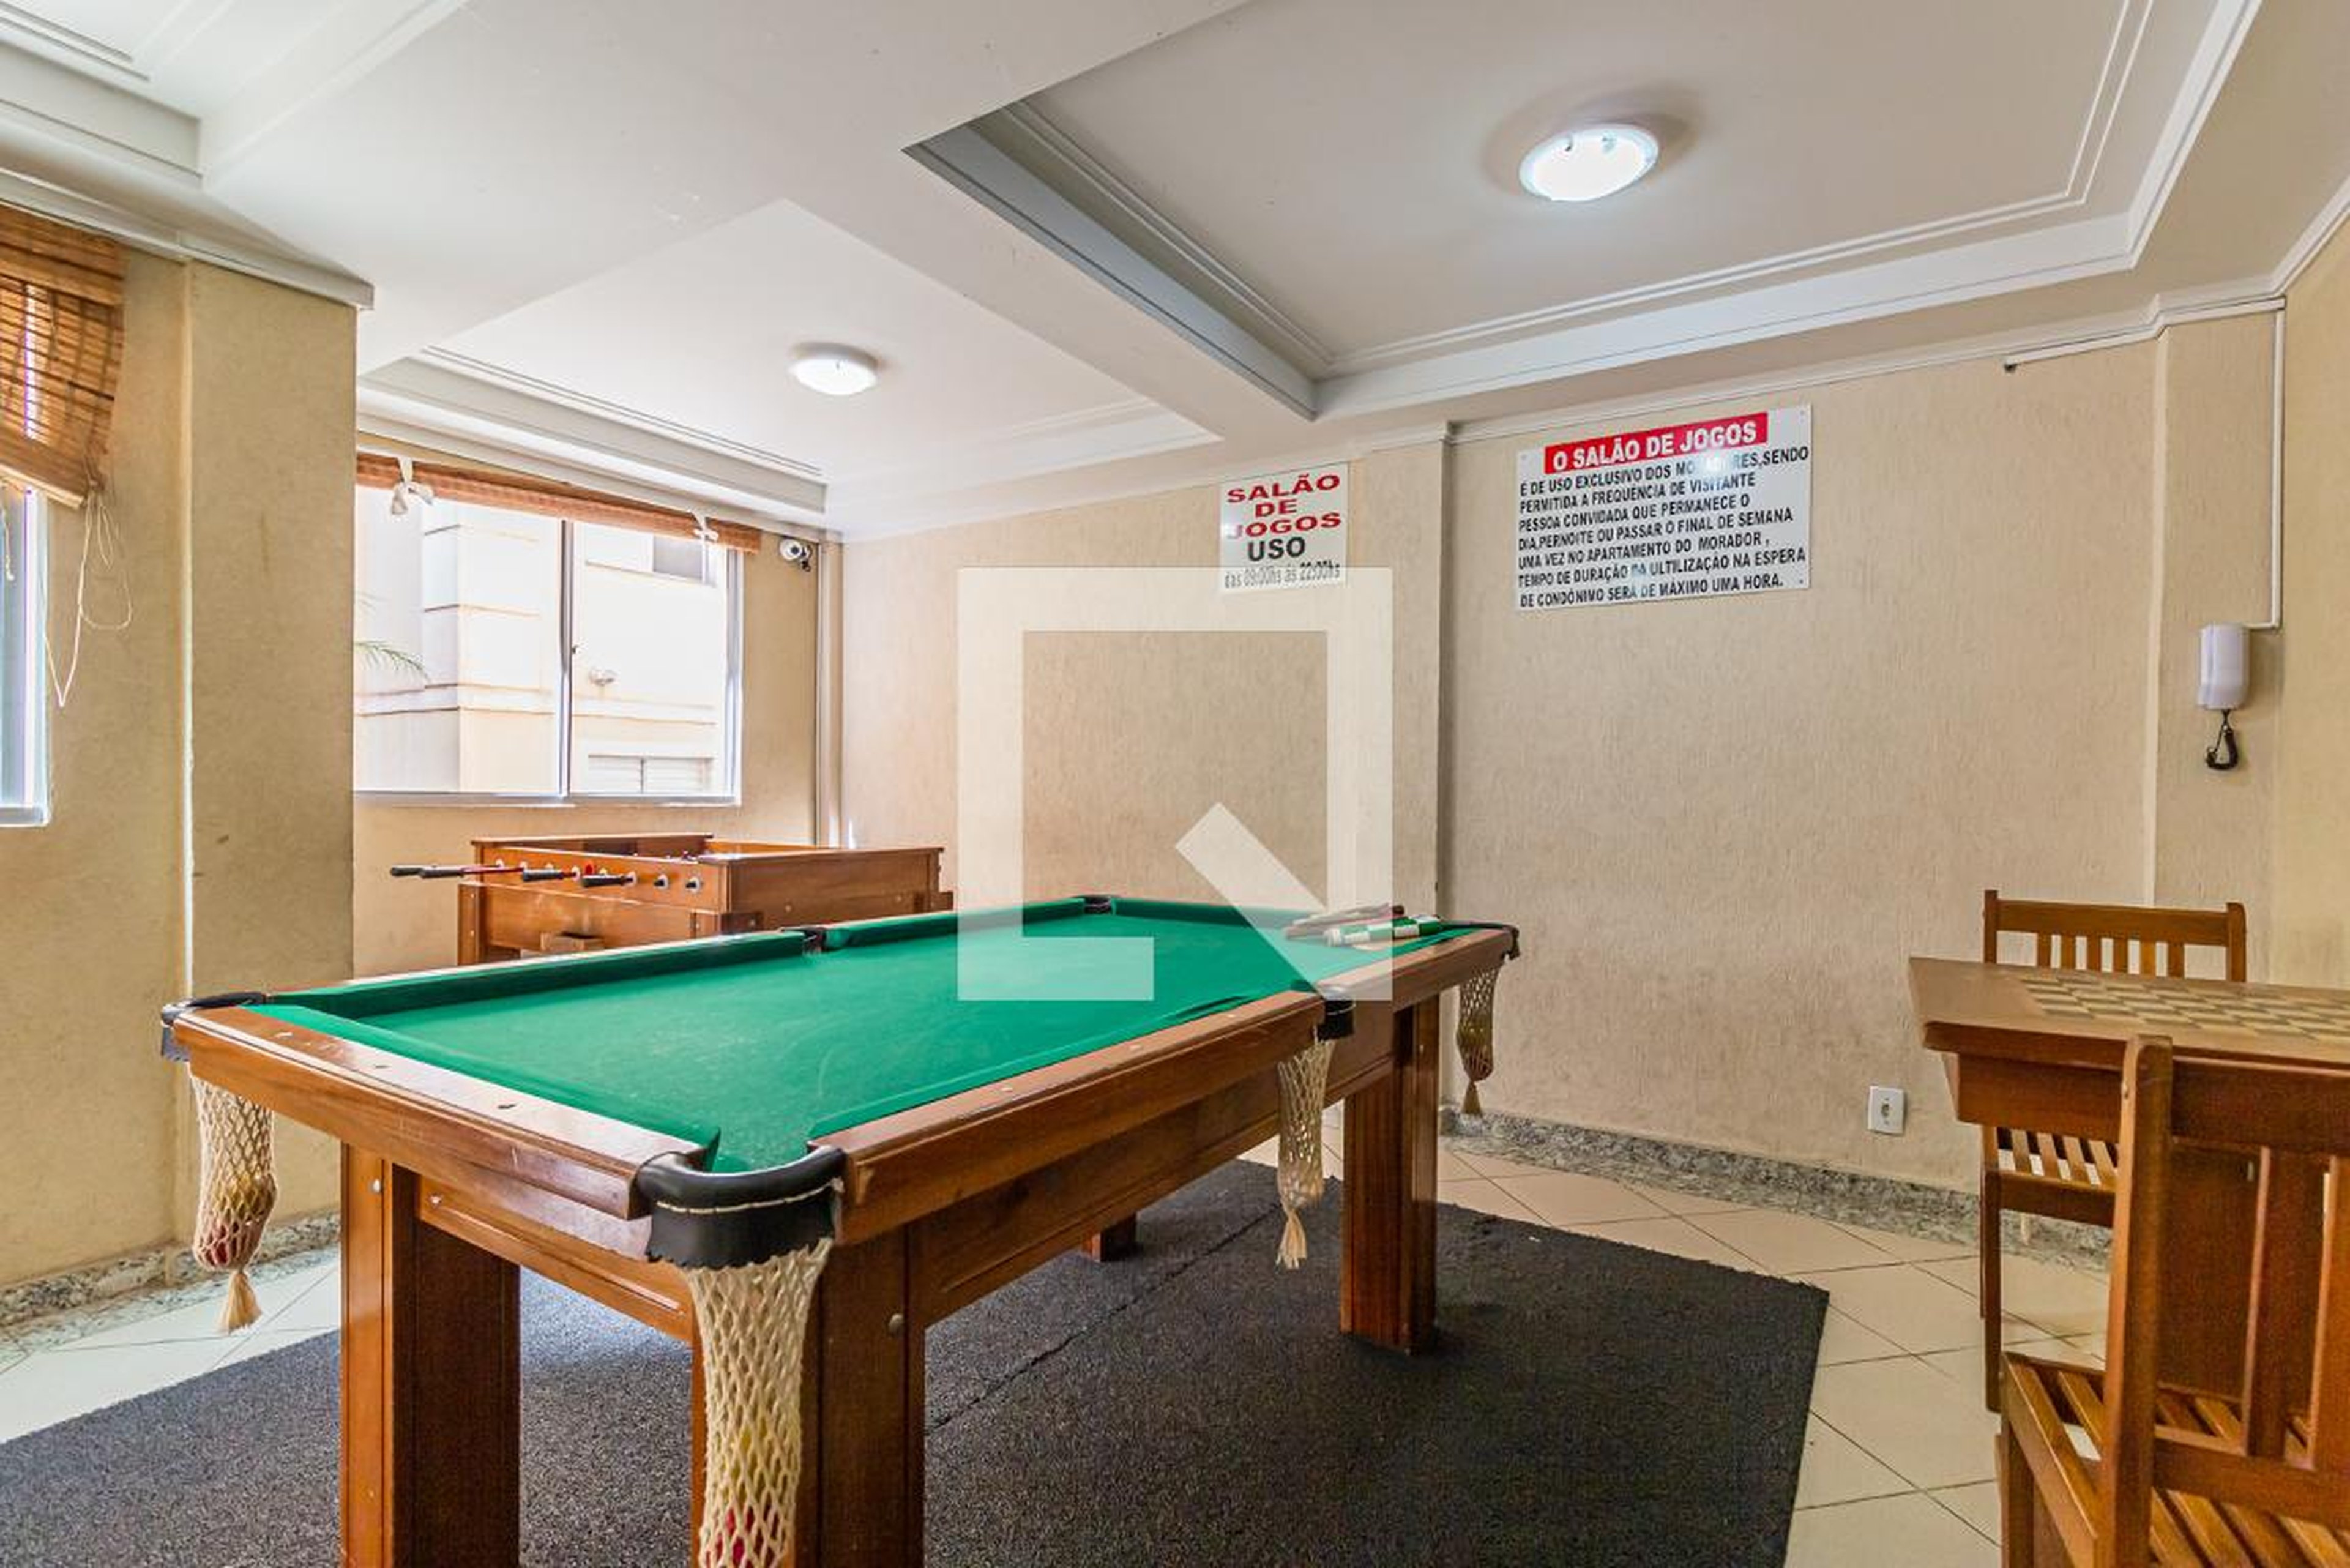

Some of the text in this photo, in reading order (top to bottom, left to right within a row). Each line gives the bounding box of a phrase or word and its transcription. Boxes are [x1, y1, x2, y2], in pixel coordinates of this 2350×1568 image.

[1553, 420, 1758, 470] O SALÃO DE JOGOS
[1226, 473, 1340, 503] SALÃO
[1520, 495, 1578, 514] PERMITIDA
[1581, 493, 1590, 507] A
[1669, 481, 1686, 496] DE
[1690, 471, 1756, 493] VISITANTE
[1531, 480, 1546, 495] DE
[1549, 477, 1572, 493] USO
[1575, 469, 1643, 489] EXCLUSIVO
[1646, 464, 1671, 480] DOS
[1226, 512, 1341, 539] JOGOS
[1255, 499, 1297, 518] DE
[1518, 493, 1750, 532] PESSOA CONVIDADA QUE PERMANECE O
[1597, 528, 1614, 542] OU
[1617, 522, 1662, 540] PASSAR
[1665, 520, 1674, 534] O
[1677, 517, 1714, 534] FINAL
[1718, 513, 1734, 529] DE
[1738, 507, 1794, 527] SEMANA
[1248, 537, 1305, 561] USO
[1518, 554, 1542, 570] UMA
[1545, 552, 1564, 566] VEZ
[1567, 550, 1584, 564] NO
[1586, 541, 1671, 562] APARTAMENTO
[1676, 538, 1692, 552] DO
[1698, 531, 1761, 551] MORADOR
[1225, 570, 1242, 588] das
[1518, 572, 1554, 588] TEMPO
[1557, 570, 1571, 585] DE
[1573, 562, 1628, 584] DURAÇÃO
[1733, 552, 1751, 568] NA
[1755, 546, 1805, 566] ESPERA
[1520, 593, 1535, 608] DE
[1641, 583, 1657, 598] DE
[1712, 576, 1740, 591] UMA
[1744, 573, 1783, 591] HORA.
